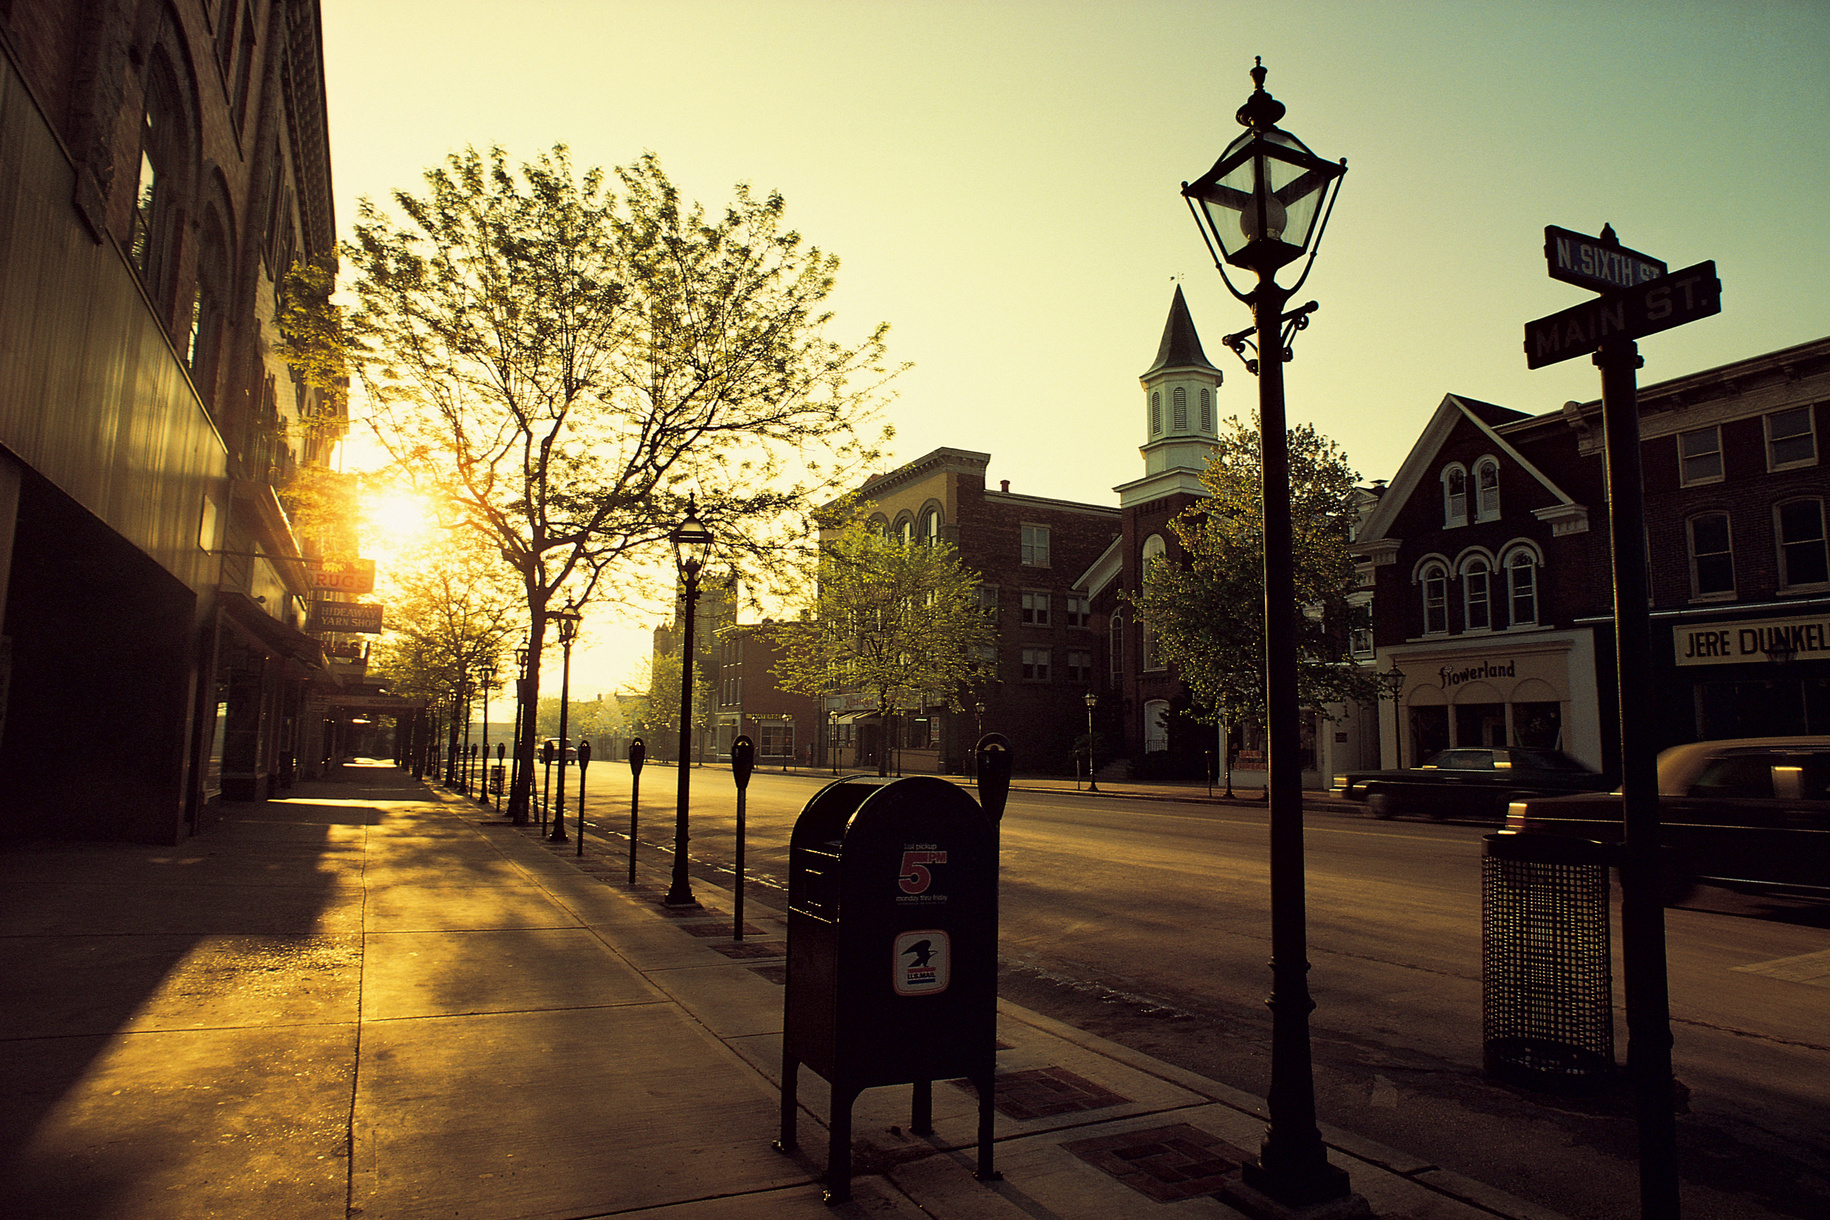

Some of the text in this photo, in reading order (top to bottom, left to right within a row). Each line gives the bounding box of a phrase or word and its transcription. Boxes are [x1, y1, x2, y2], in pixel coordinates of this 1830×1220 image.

[1556, 236, 1578, 272] N.
[1580, 243, 1634, 288] SIXTH
[1535, 274, 1709, 359] MAIN ST.
[321, 606, 377, 619] HIDEAWAY
[321, 616, 378, 628] YARN SHOP
[1685, 623, 1830, 658] JERE DUNKEL
[1438, 660, 1516, 690] flowerland
[916, 843, 937, 851] pickup
[933, 894, 947, 902] friday
